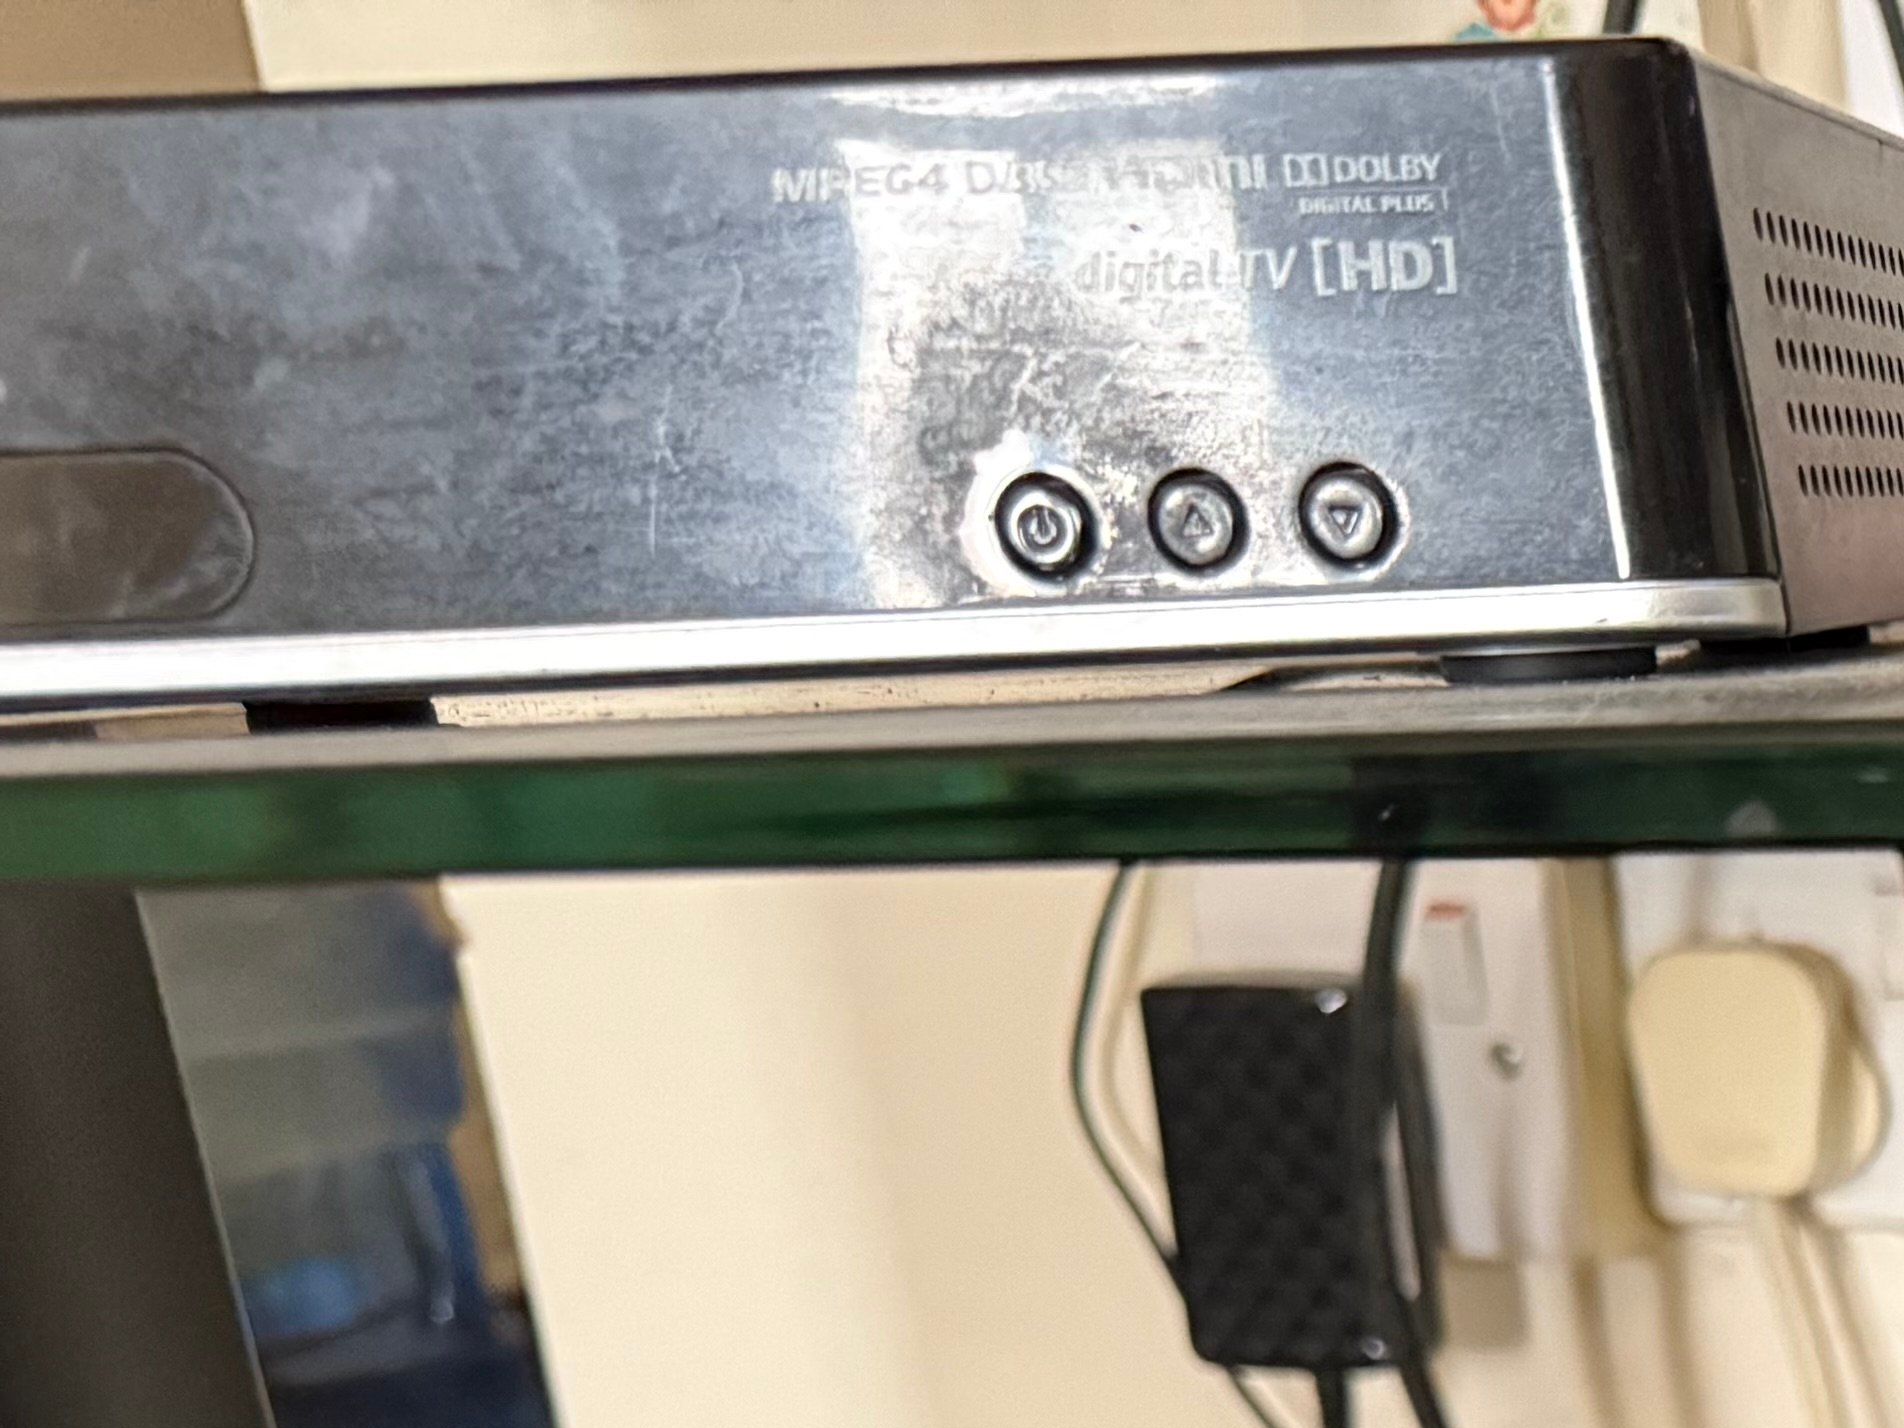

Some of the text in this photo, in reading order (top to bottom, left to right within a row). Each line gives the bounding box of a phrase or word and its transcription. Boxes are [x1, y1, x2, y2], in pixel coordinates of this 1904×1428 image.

[770, 161, 948, 204] MPEG4
[1333, 153, 1441, 183] DOLBY
[1380, 193, 1435, 214] PLUS
[1073, 249, 1222, 305] digital
[1237, 246, 1298, 290] TV
